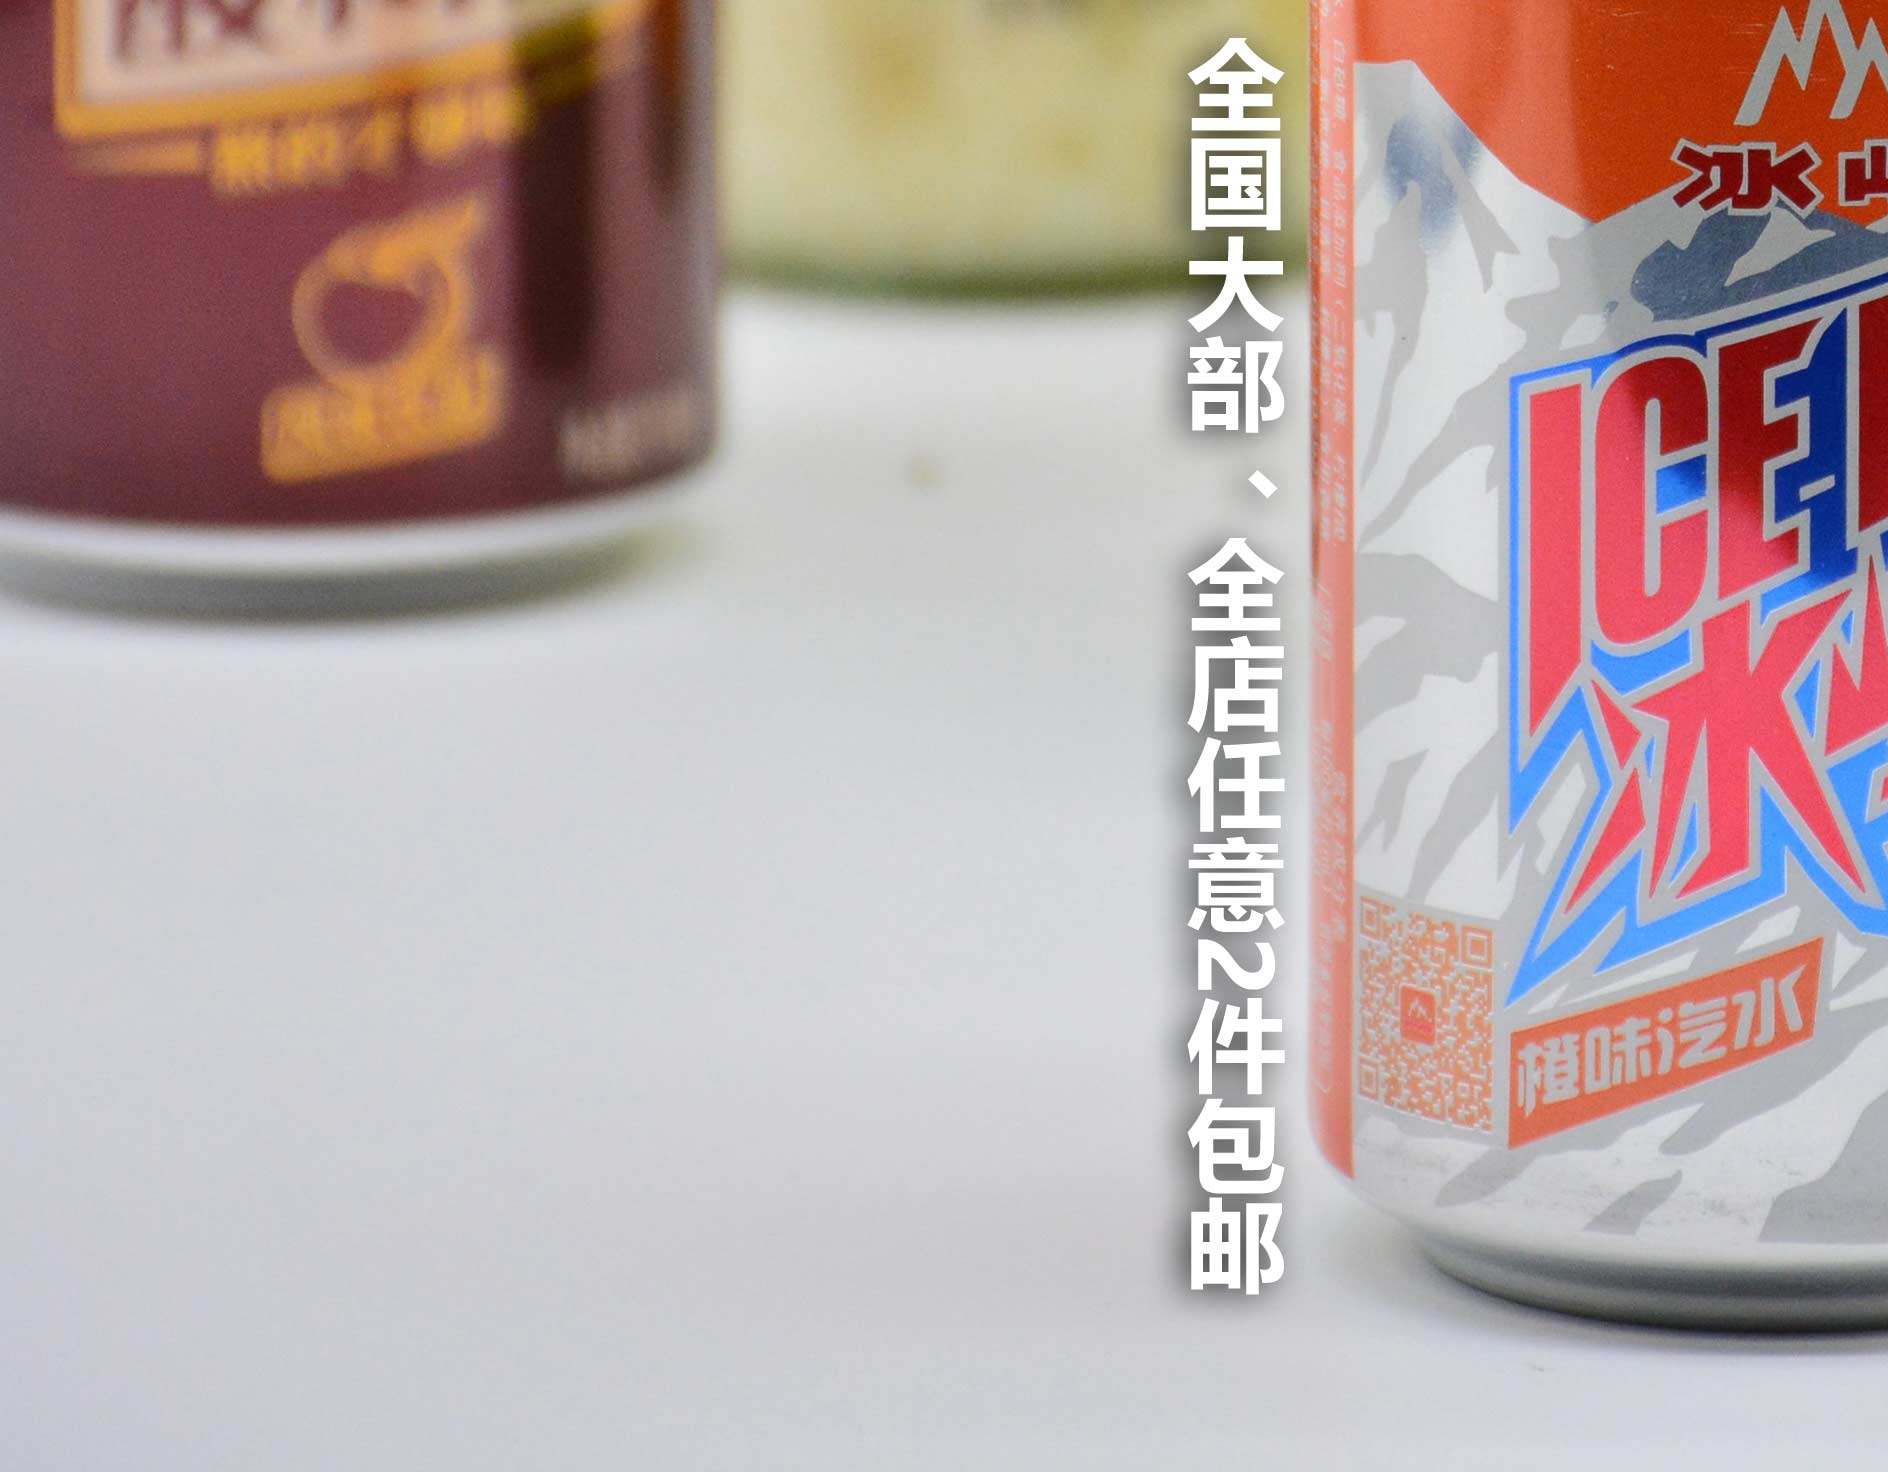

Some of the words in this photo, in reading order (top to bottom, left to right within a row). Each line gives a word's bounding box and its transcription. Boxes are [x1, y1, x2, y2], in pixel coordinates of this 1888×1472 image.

[1526, 314, 1828, 739] ICE
[1515, 975, 1806, 1115] 橙味汽水
